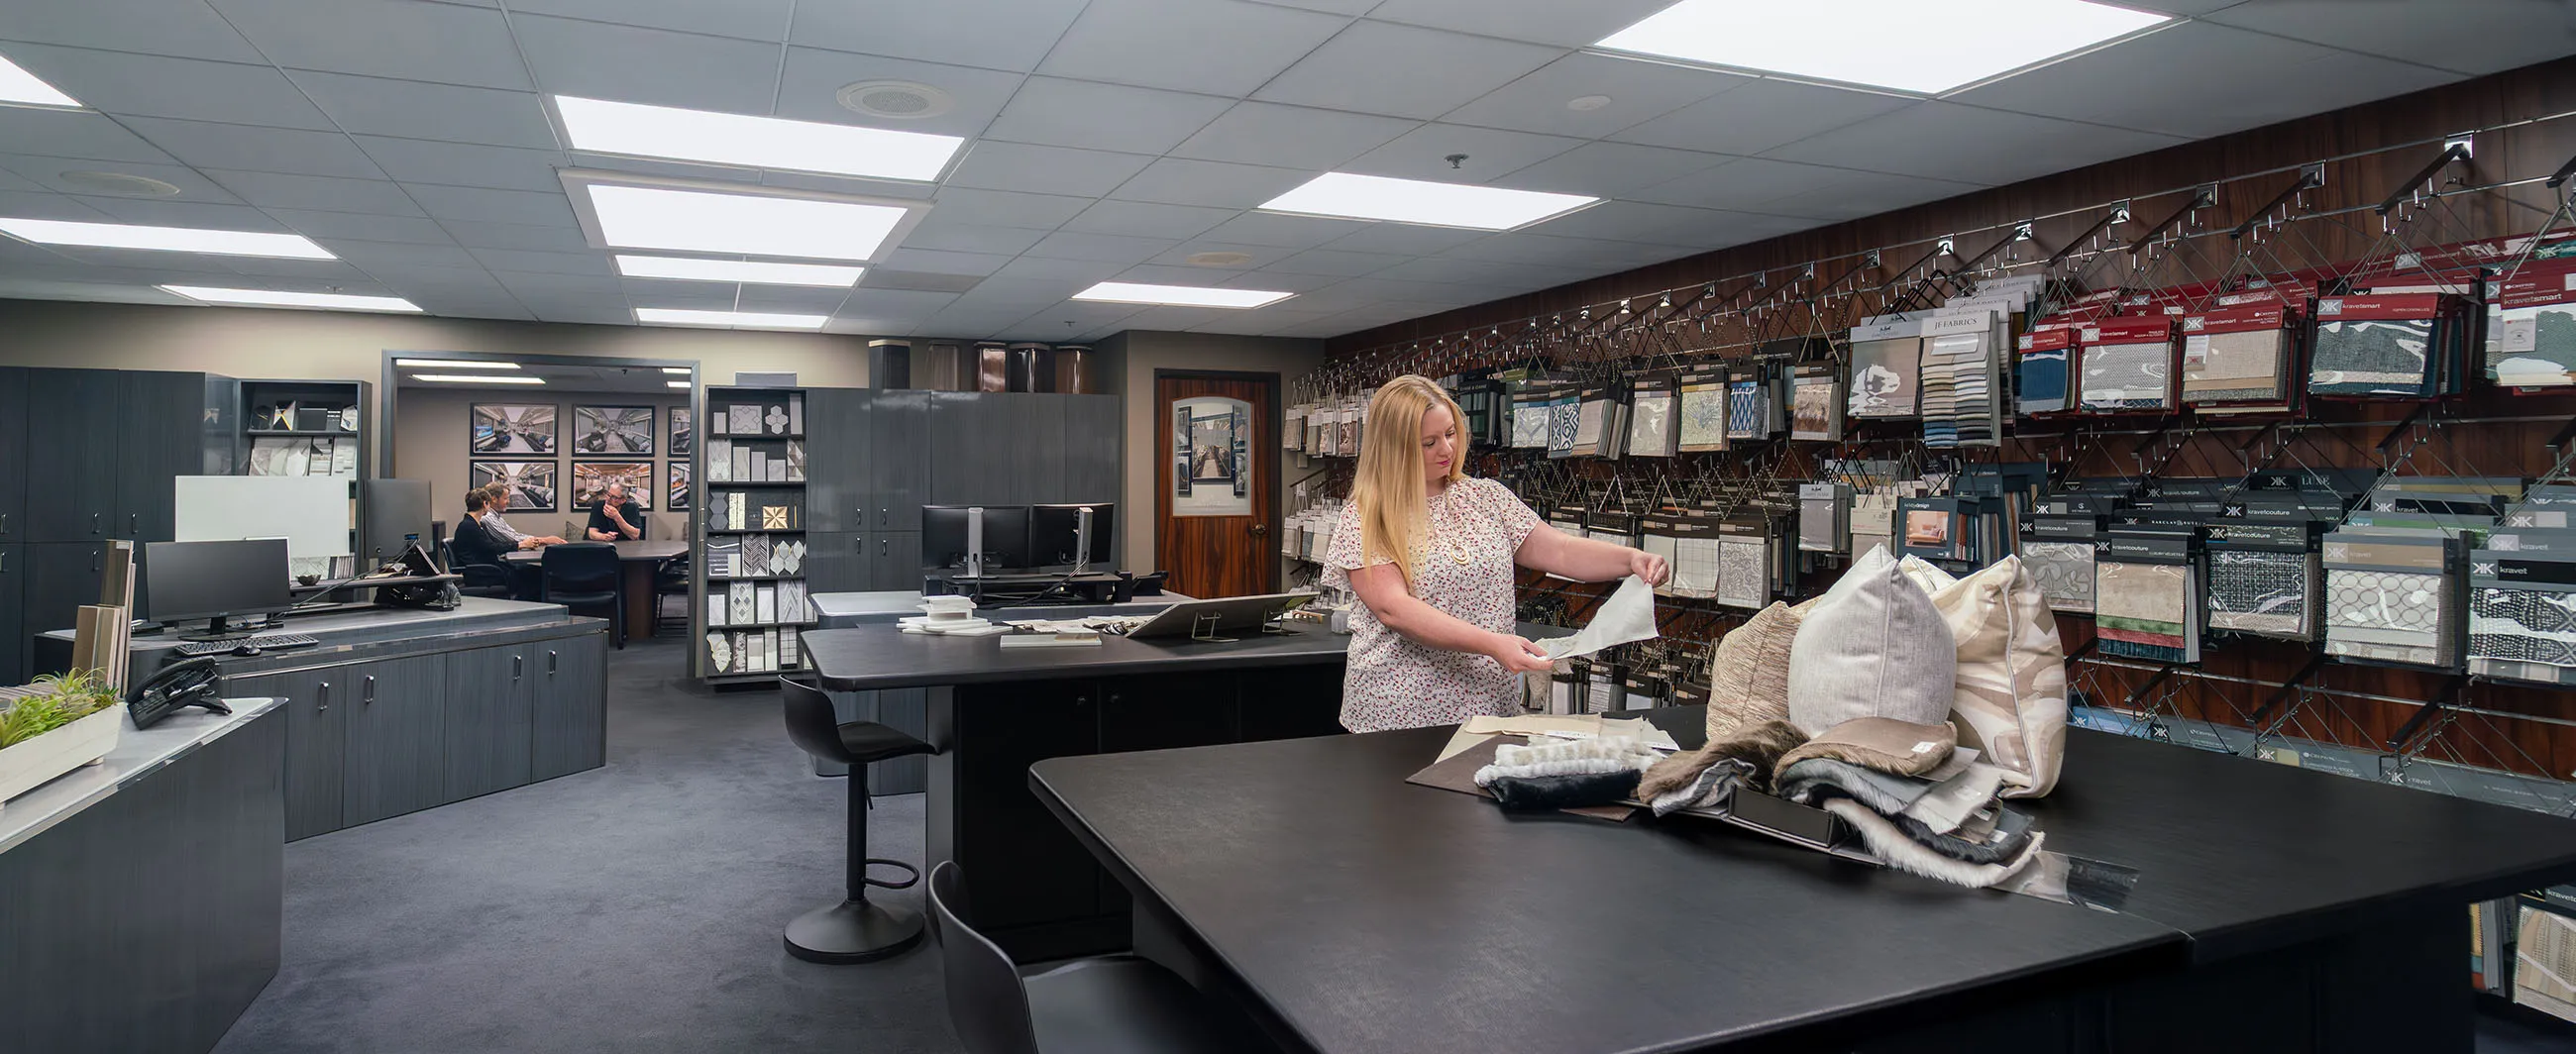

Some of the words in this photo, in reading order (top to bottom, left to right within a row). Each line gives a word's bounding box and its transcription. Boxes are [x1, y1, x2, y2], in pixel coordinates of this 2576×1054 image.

[2504, 293, 2562, 305] kravetsmart
[1944, 318, 1978, 328] FABRICS
[2500, 566, 2528, 575] kravet
